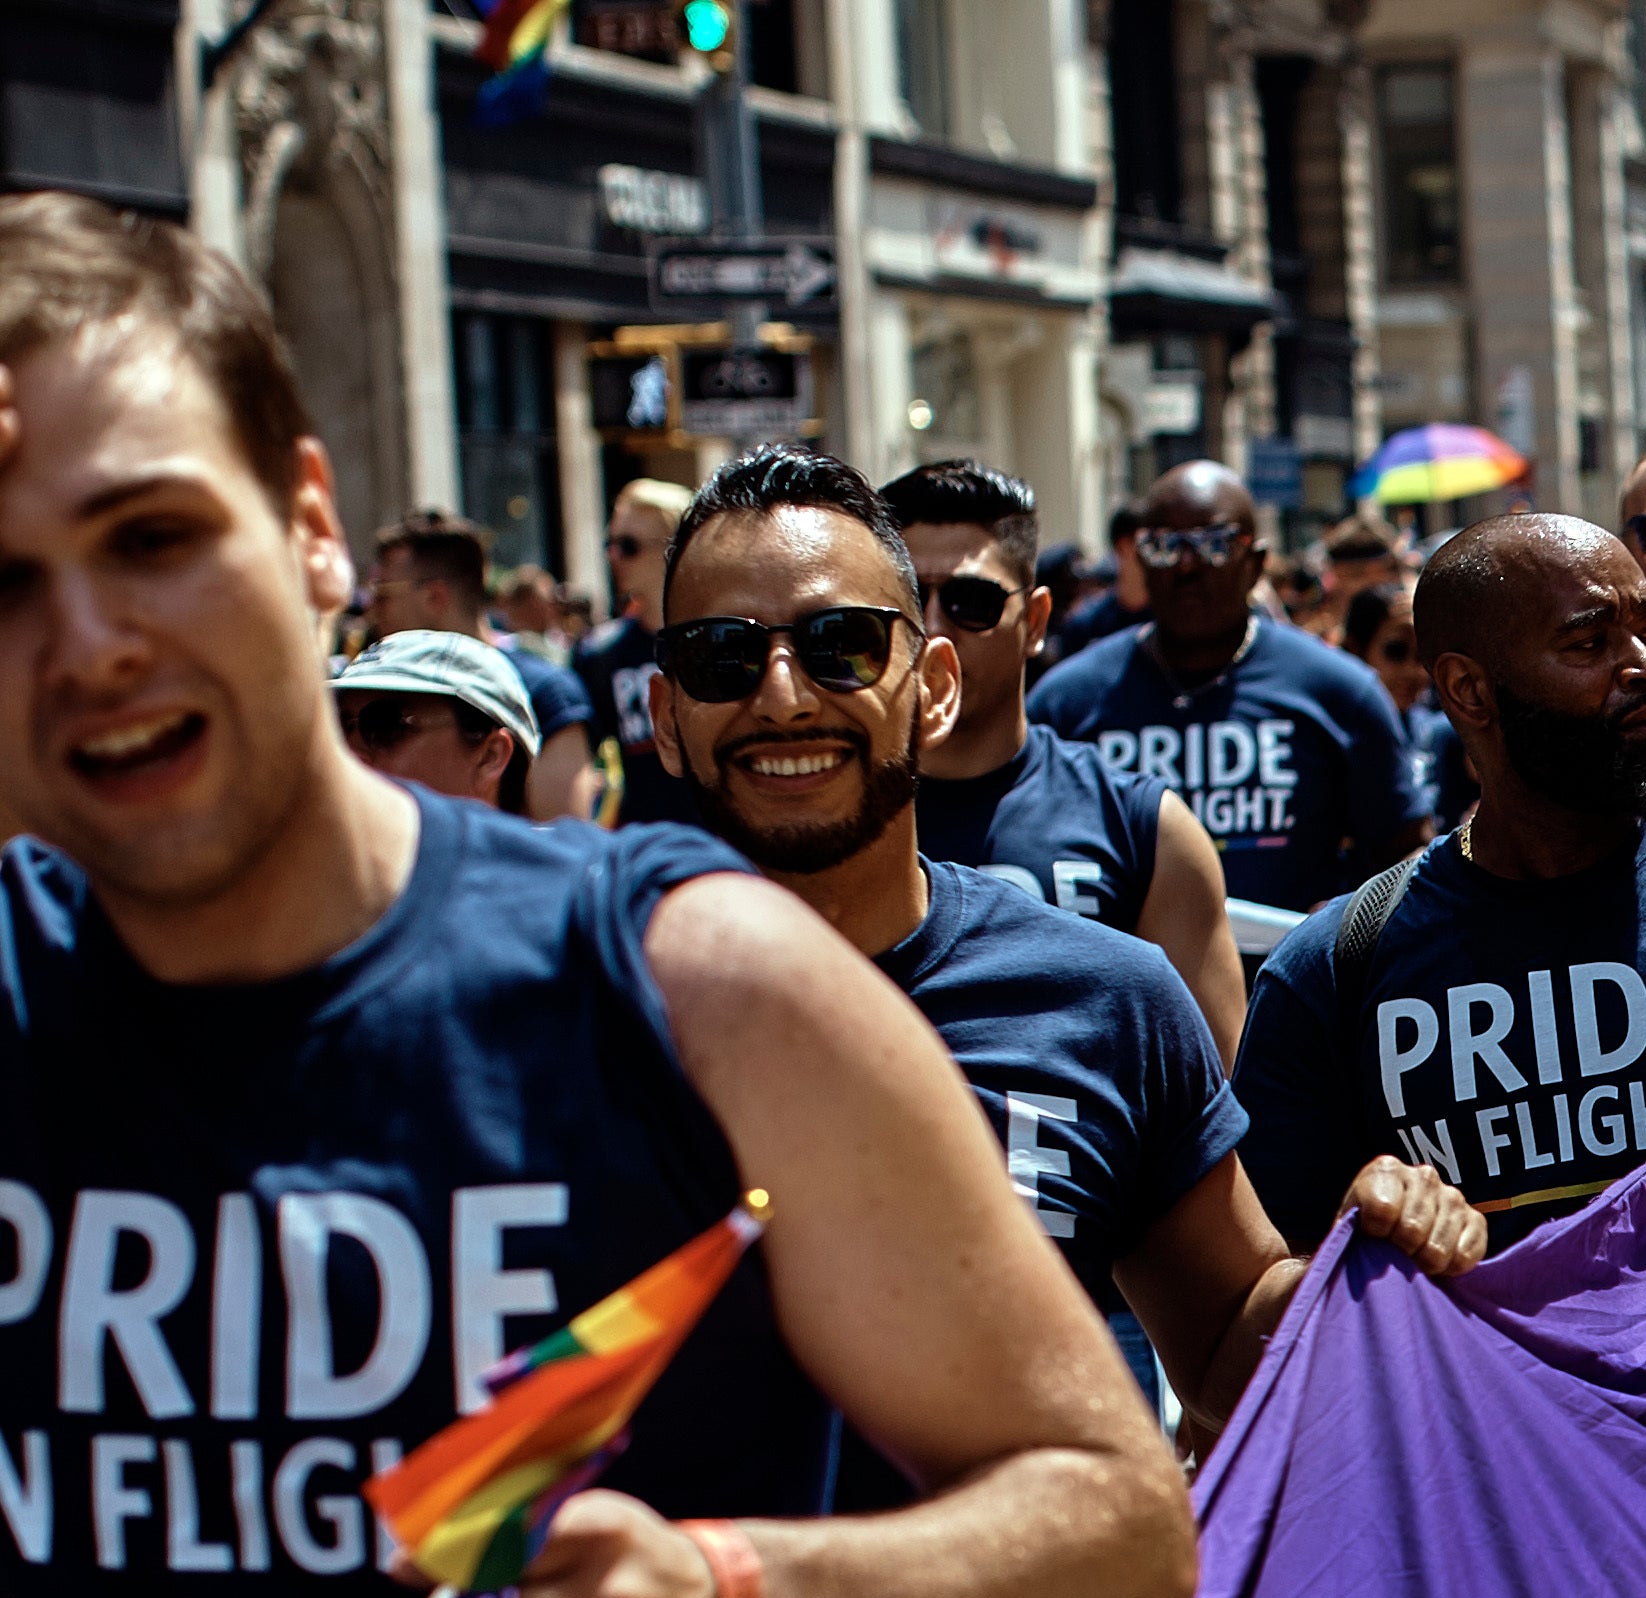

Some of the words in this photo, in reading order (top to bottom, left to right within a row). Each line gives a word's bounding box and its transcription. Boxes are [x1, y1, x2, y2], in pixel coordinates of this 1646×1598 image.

[1100, 719, 1298, 790] PRIDE
[1396, 1118, 1463, 1185] IN
[91, 1433, 406, 1574] FLIG
